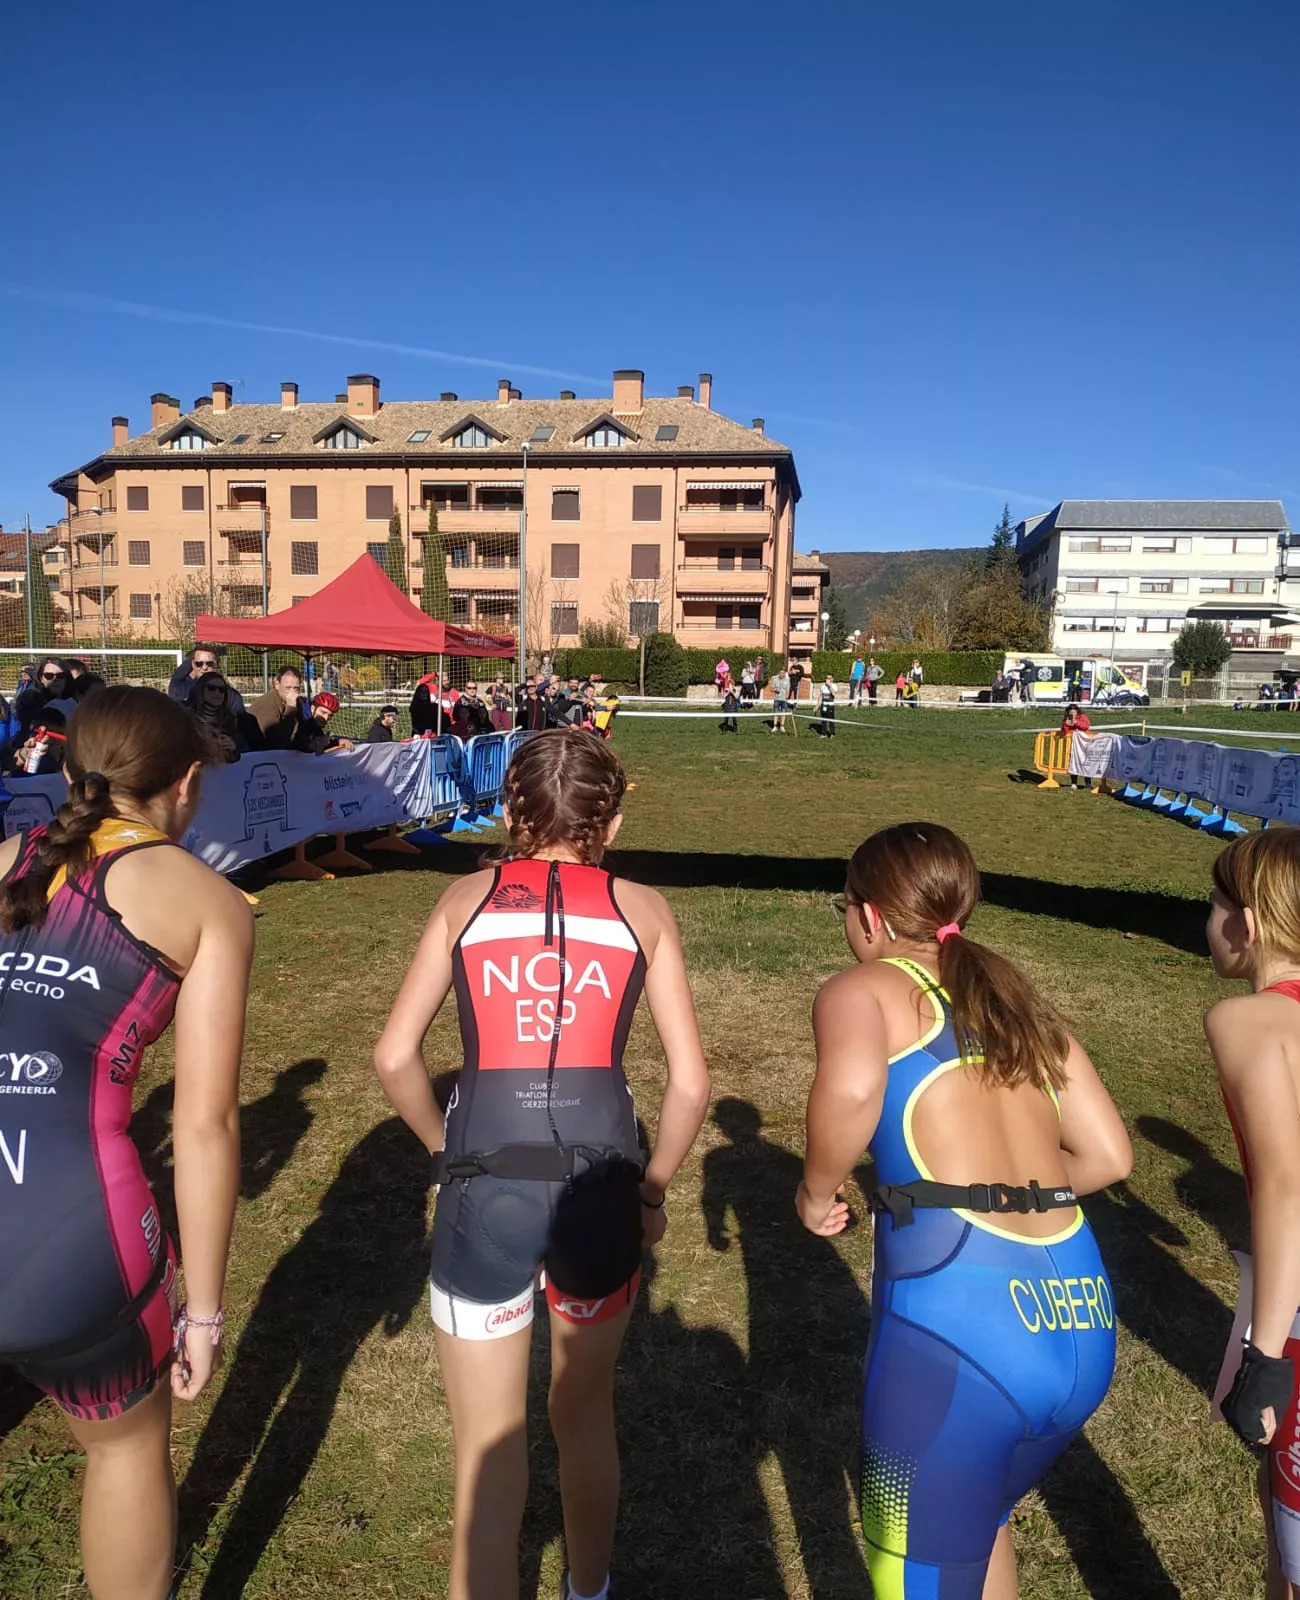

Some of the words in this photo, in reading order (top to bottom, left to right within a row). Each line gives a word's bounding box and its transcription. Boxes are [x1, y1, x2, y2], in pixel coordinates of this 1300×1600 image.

[483, 952, 611, 999] NOA
[516, 998, 577, 1042] ESP
[515, 1091, 548, 1099] TRIATLON
[522, 1100, 548, 1109] CIERZO
[1009, 1275, 1113, 1334] CUBERO
